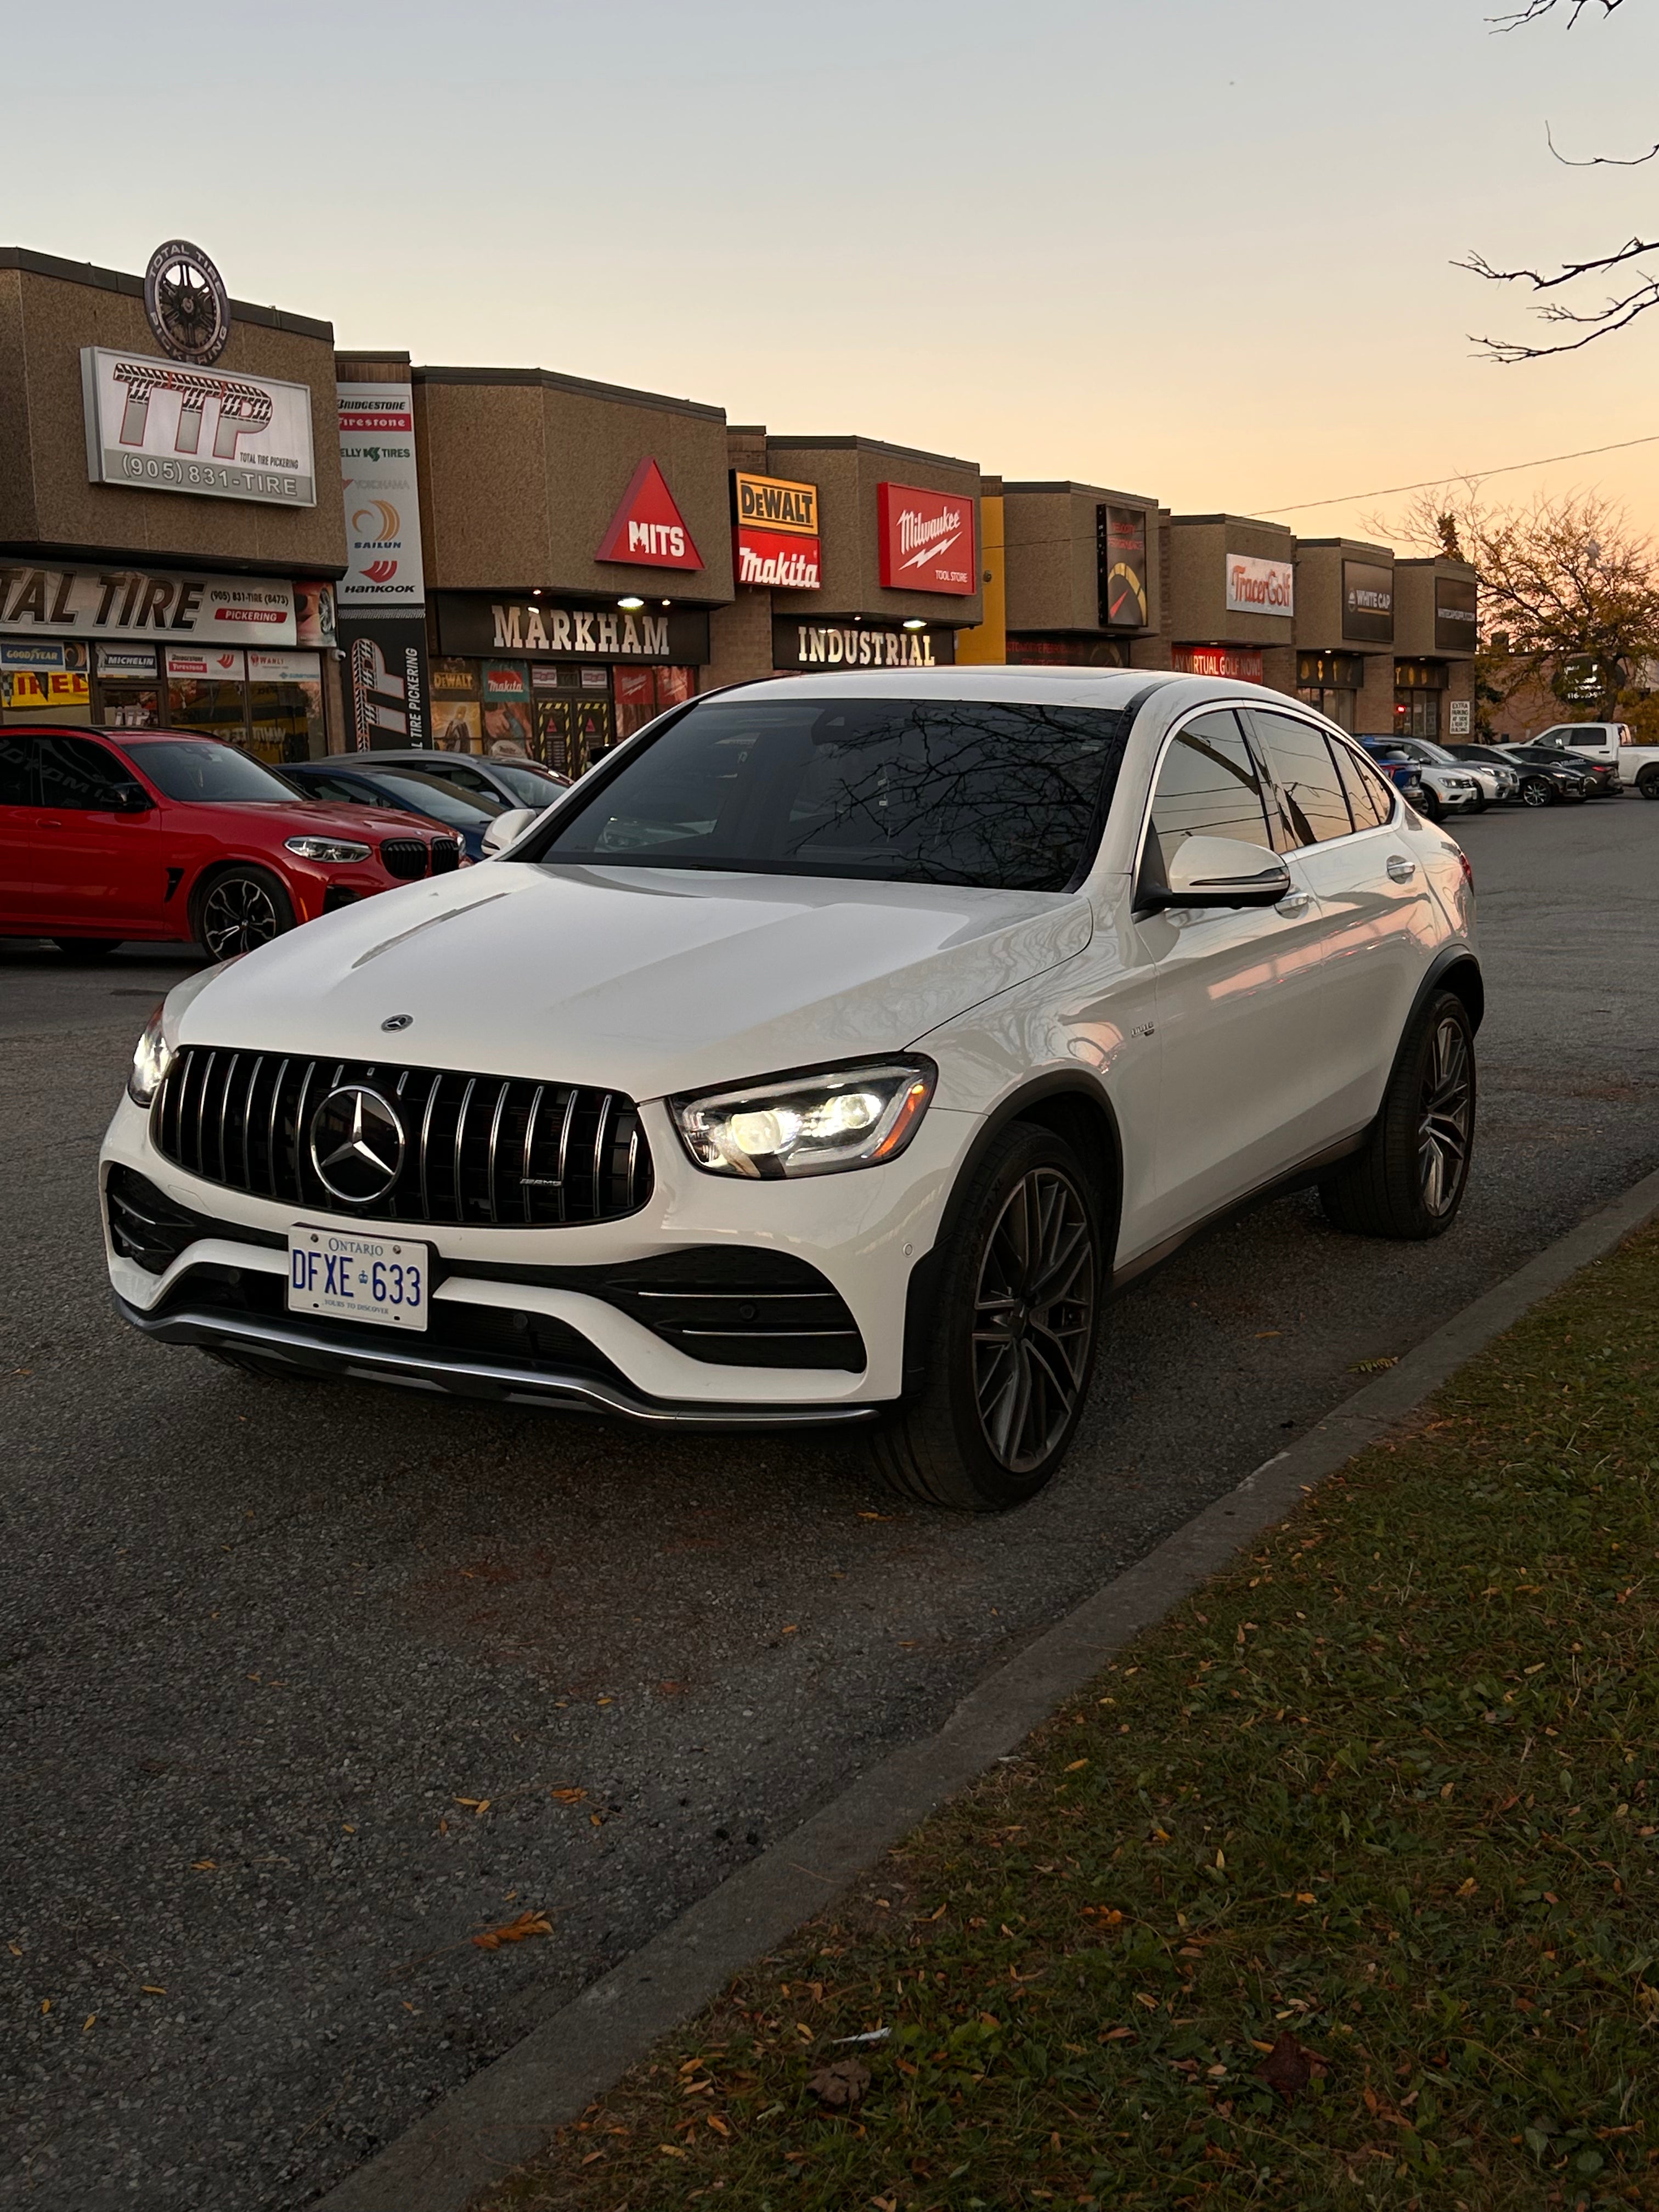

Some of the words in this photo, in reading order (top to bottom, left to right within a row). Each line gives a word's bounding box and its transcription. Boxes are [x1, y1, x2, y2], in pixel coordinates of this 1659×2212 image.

[149, 244, 189, 278] TOTAL
[196, 252, 222, 295] TIRE
[113, 363, 273, 460] TTP
[338, 399, 405, 410] BRIDGESTONE
[240, 452, 255, 465] TOTAL
[257, 454, 268, 466] TIRE
[270, 456, 299, 470] PICKERING
[381, 449, 410, 458] TIRES
[122, 453, 183, 484] (905)
[188, 466, 297, 496] 831-TIRE
[741, 484, 812, 523] DEWALT
[628, 521, 686, 557] MITS
[896, 506, 961, 555] Milwaukee
[935, 570, 950, 581] TOOL
[950, 572, 968, 583] STORE
[93, 574, 208, 632] TIRE
[211, 591, 230, 603] (905)
[233, 592, 262, 603] 831-TIRE
[264, 594, 289, 607] (8473)
[1356, 590, 1378, 607] WHITE
[1378, 593, 1391, 609] CAP
[225, 610, 277, 622] PICKERING
[492, 606, 670, 655] MARKHAM
[7, 648, 58, 661] GOODYEAR
[798, 626, 935, 666] INDUSTRIAL
[108, 657, 154, 666] MICHELIN
[172, 663, 204, 672] Firestone
[260, 657, 284, 665] WANLI
[1186, 655, 1218, 675] VIRTUAL
[1220, 656, 1240, 675] GOLF
[1240, 658, 1261, 676] NOW!
[405, 647, 421, 710] PICKERING
[435, 673, 472, 689] DEWALT
[410, 713, 422, 738] TIRE
[329, 1238, 383, 1256] ONTARIO
[292, 1249, 354, 1298] DFXE
[372, 1261, 420, 1307] 633
[324, 1299, 345, 1308] YOURS
[357, 1305, 389, 1314] DISCOVER
